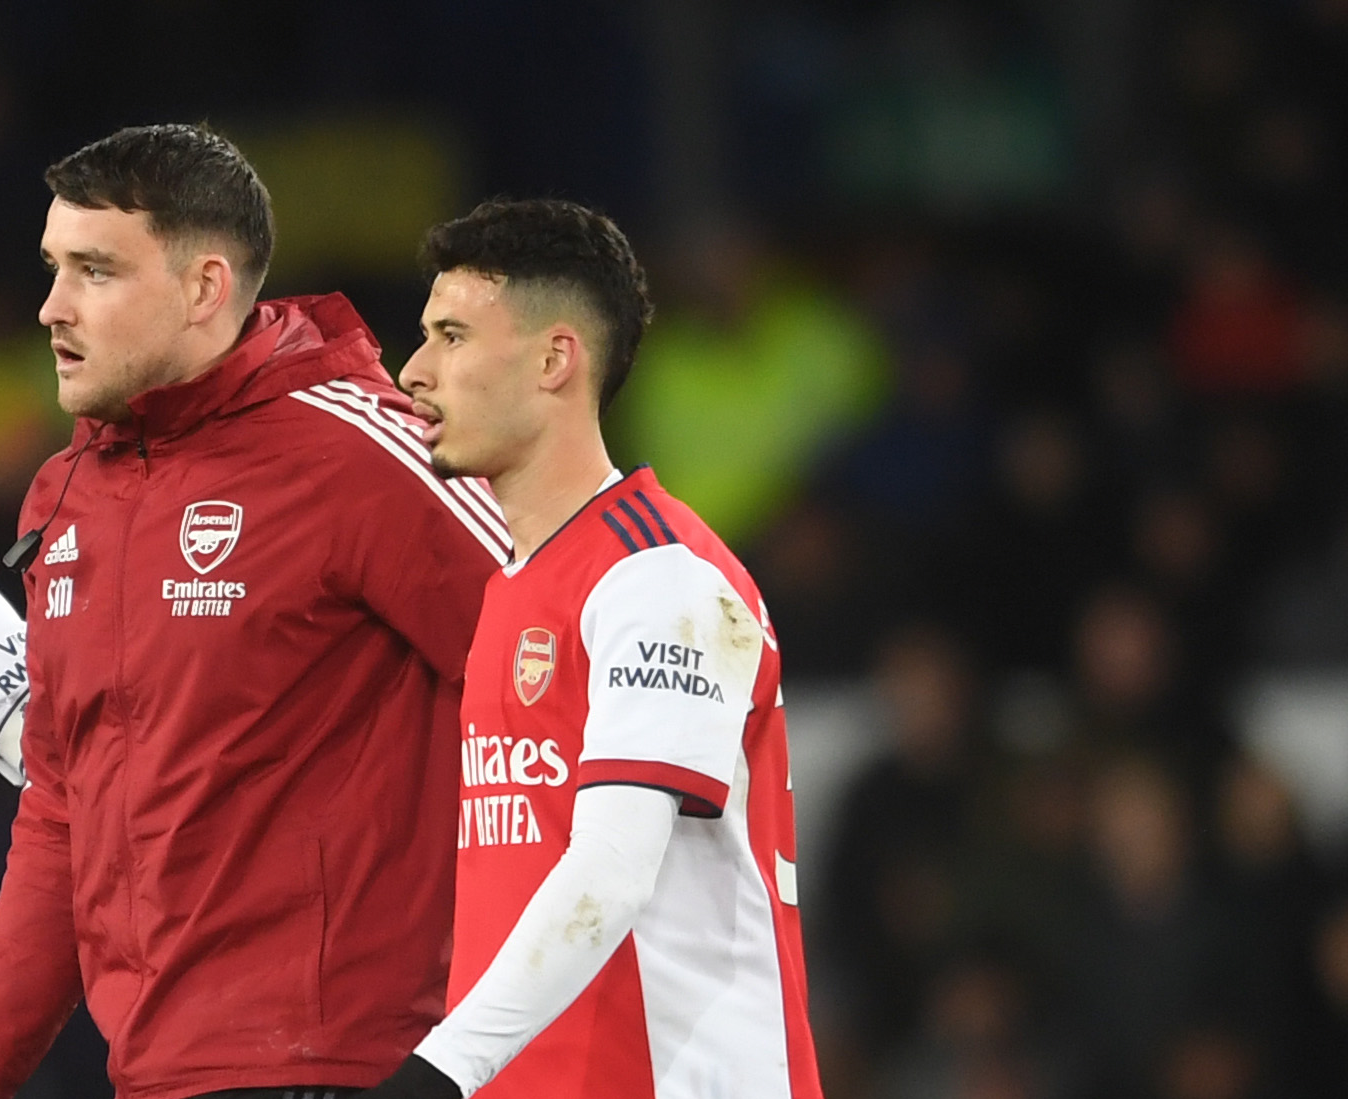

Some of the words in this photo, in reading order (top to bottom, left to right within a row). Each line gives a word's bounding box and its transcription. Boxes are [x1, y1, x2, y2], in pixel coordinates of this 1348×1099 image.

[190, 513, 234, 526] Arsenal
[44, 548, 79, 565] adidas
[161, 577, 247, 600] Emirates
[171, 600, 190, 617] FLY
[190, 600, 232, 617] BETTER
[637, 641, 704, 671] VISIT
[608, 666, 725, 704] RWANDA
